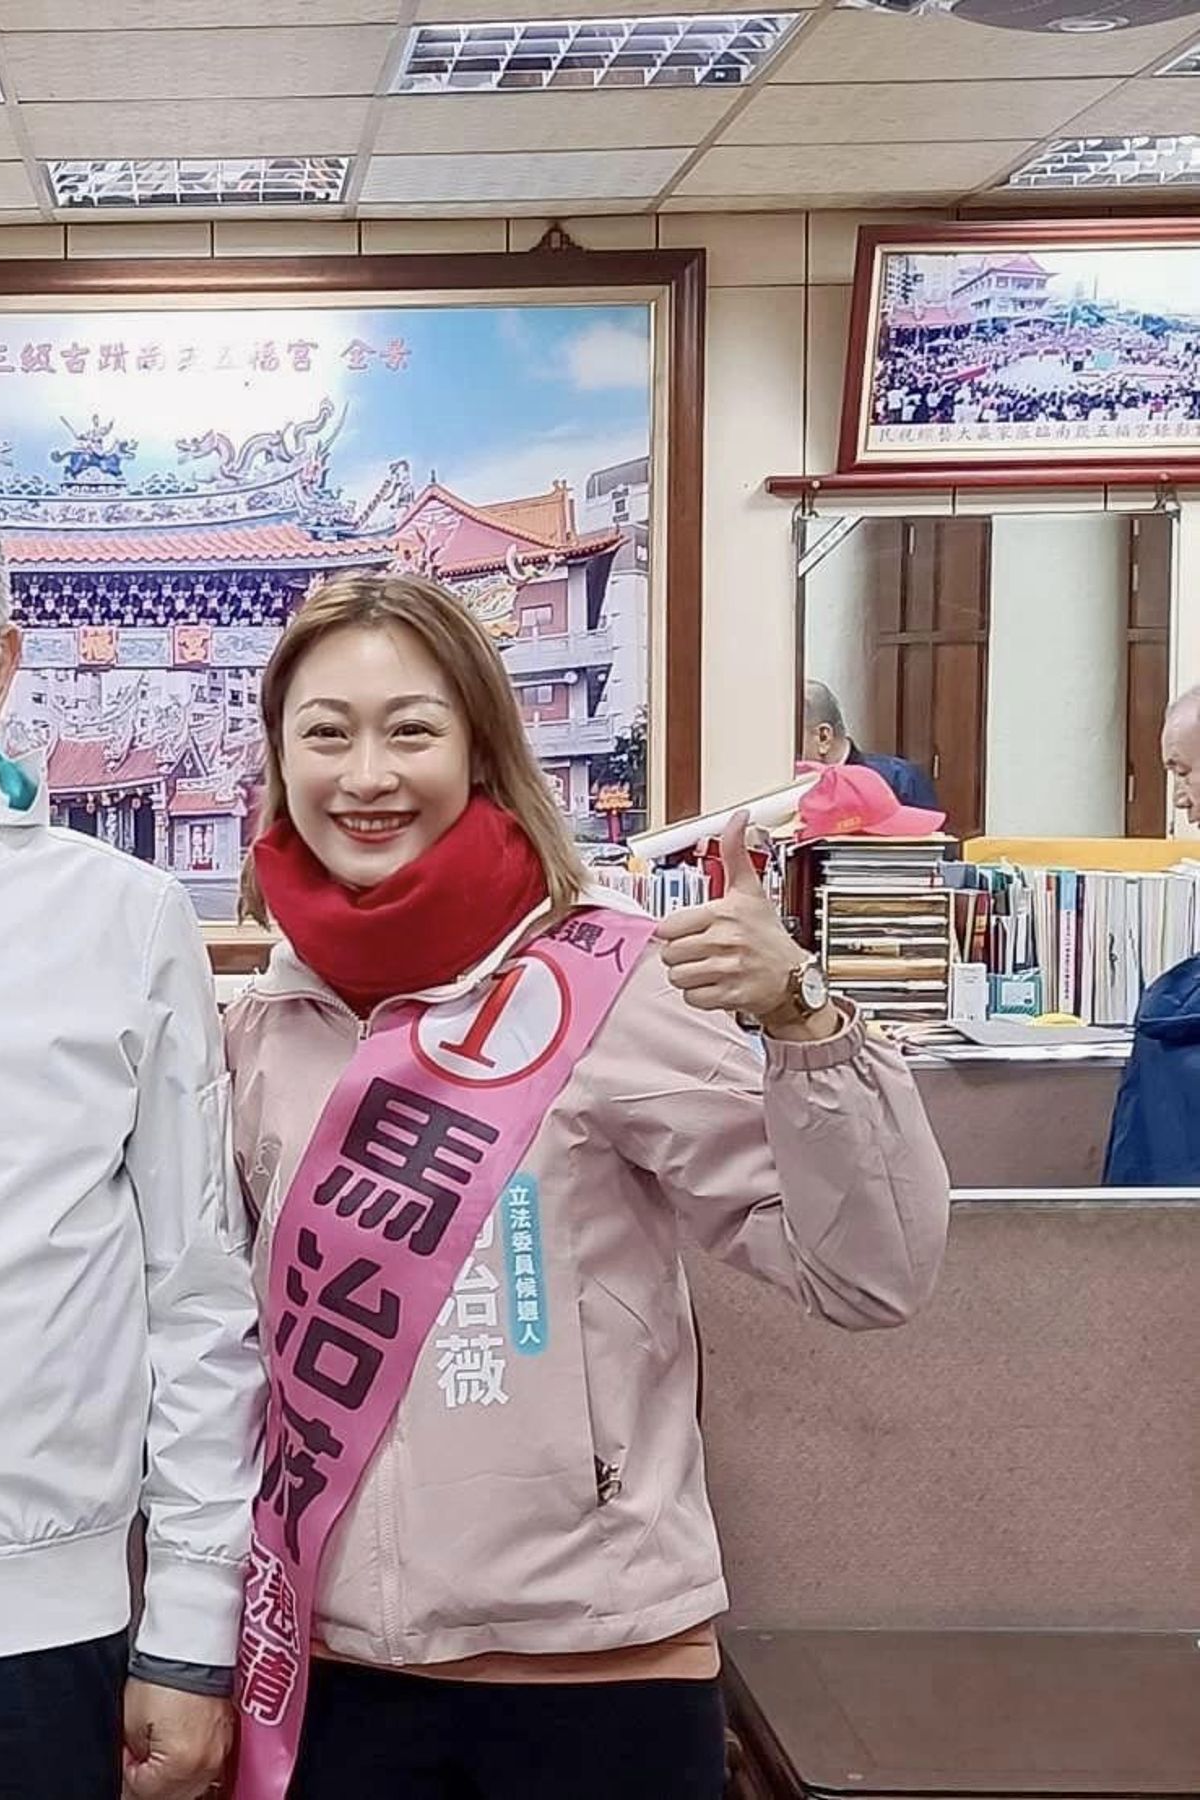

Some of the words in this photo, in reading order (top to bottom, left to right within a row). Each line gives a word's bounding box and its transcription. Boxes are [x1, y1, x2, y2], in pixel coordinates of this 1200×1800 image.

[340, 337, 413, 373] 全景
[544, 920, 625, 974] 選人
[439, 962, 529, 1069] 1
[435, 1214, 509, 1407] 治薇
[508, 1185, 541, 1345] 立法委員候選人
